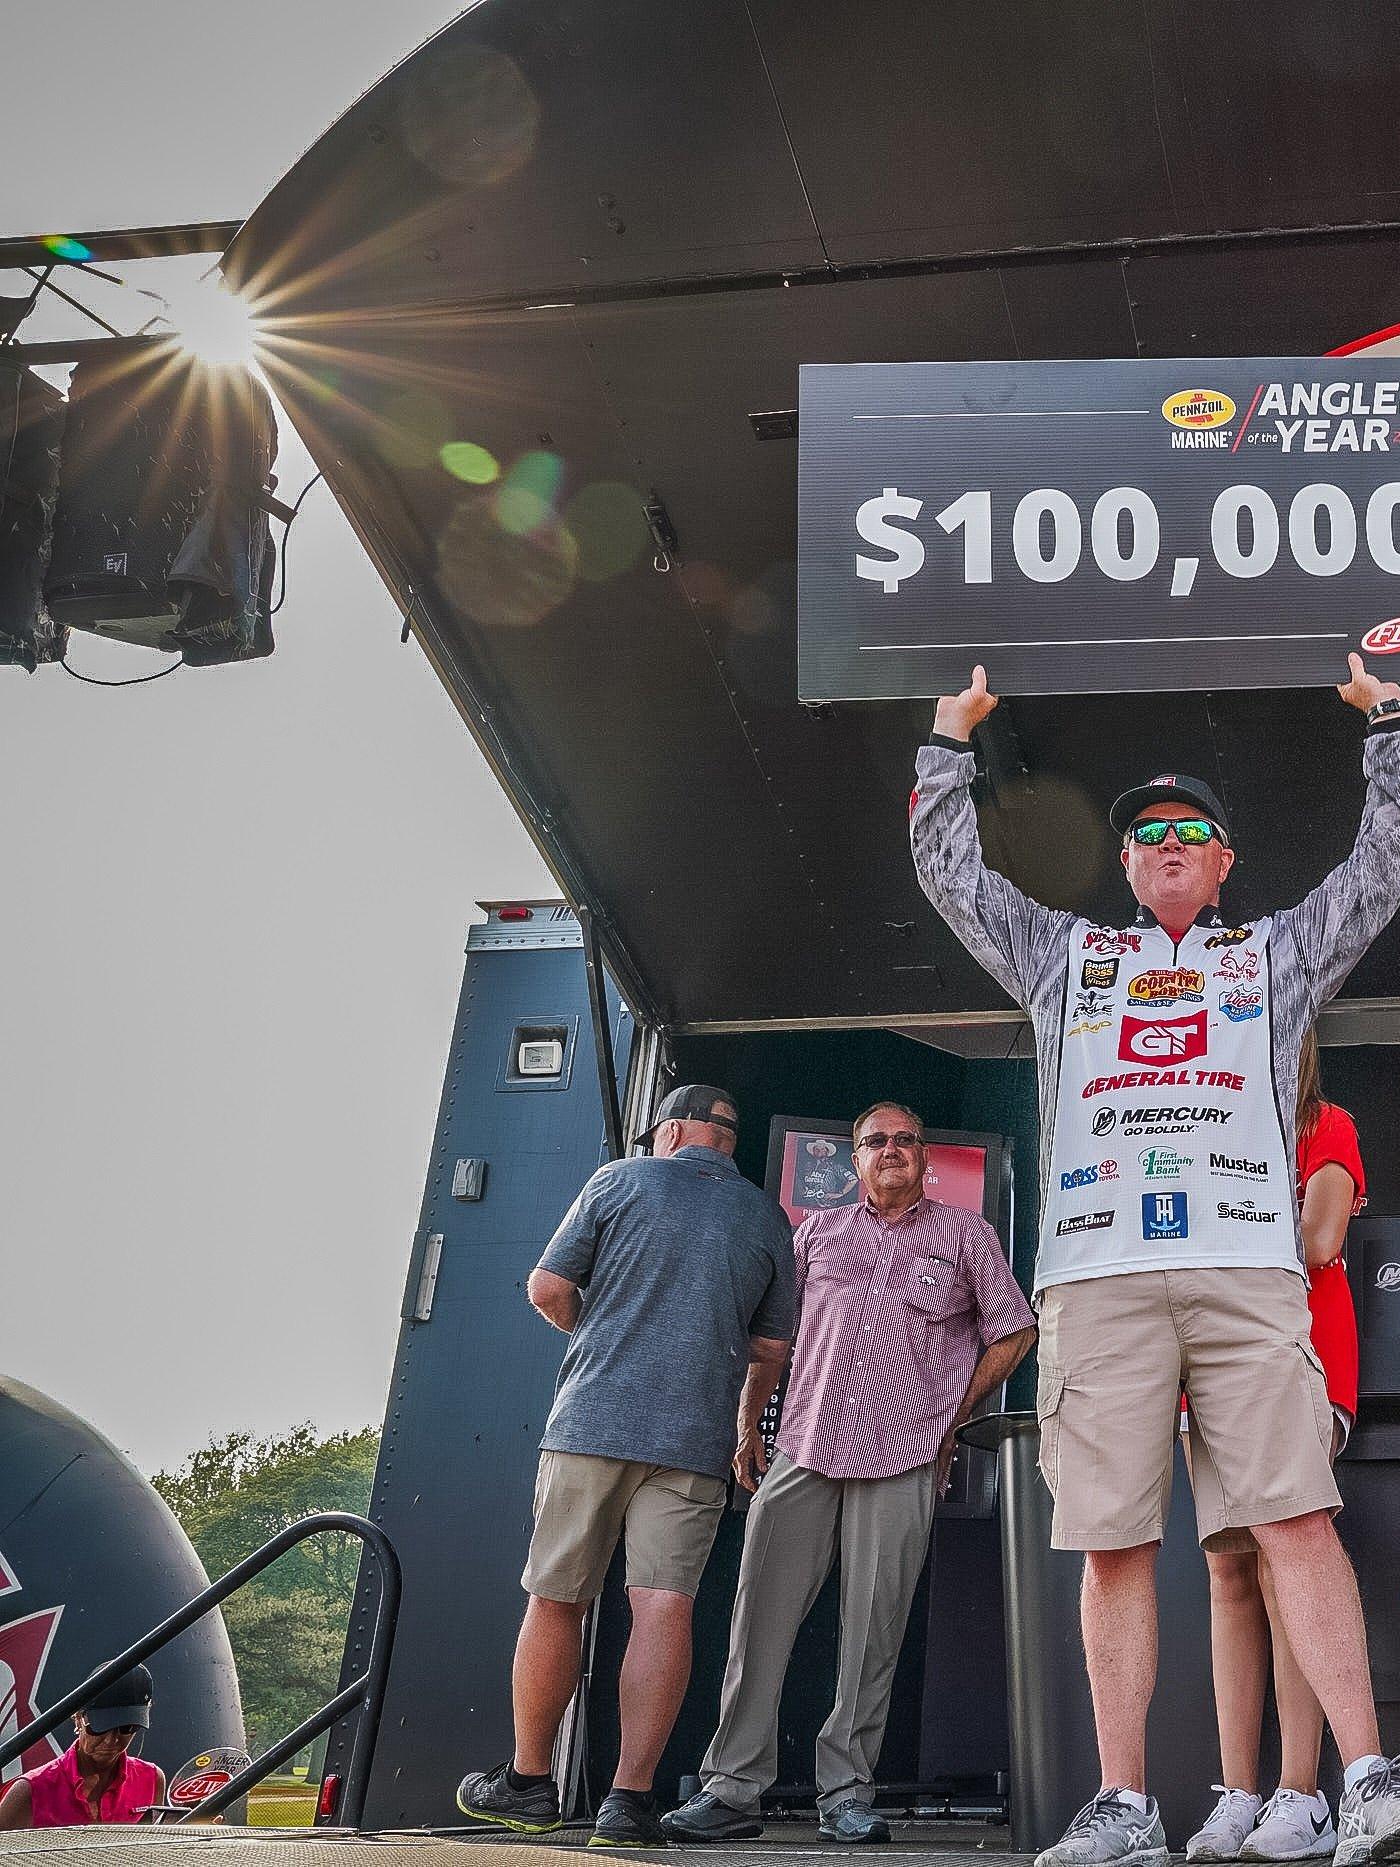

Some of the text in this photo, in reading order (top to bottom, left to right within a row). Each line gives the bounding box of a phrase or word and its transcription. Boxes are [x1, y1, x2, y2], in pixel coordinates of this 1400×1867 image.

[1172, 400, 1225, 418] PENNZOIL
[1171, 431, 1229, 449] MARINE
[1247, 431, 1258, 445] of
[1261, 431, 1278, 443] the
[1274, 419, 1391, 453] YEAR
[1085, 961, 1115, 970] GRIME
[1085, 968, 1114, 977] BOSS
[1226, 993, 1261, 1008] LUCAS
[1081, 1070, 1246, 1099] GENERAL TIRE
[1120, 1107, 1234, 1125] MERCURY
[1123, 1127, 1143, 1136] GO
[1160, 1151, 1177, 1159] First
[1209, 1152, 1268, 1175] Mustad
[1156, 1165, 1180, 1175] Bank
[927, 1176, 939, 1185] AR
[1099, 1173, 1120, 1182] TOYOTA
[770, 1394, 779, 1404] 9
[764, 1407, 777, 1417] 10
[760, 1421, 775, 1430] 11
[761, 1434, 775, 1444] 12
[765, 1448, 773, 1458] 3
[213, 1754, 248, 1766] ANGLER
